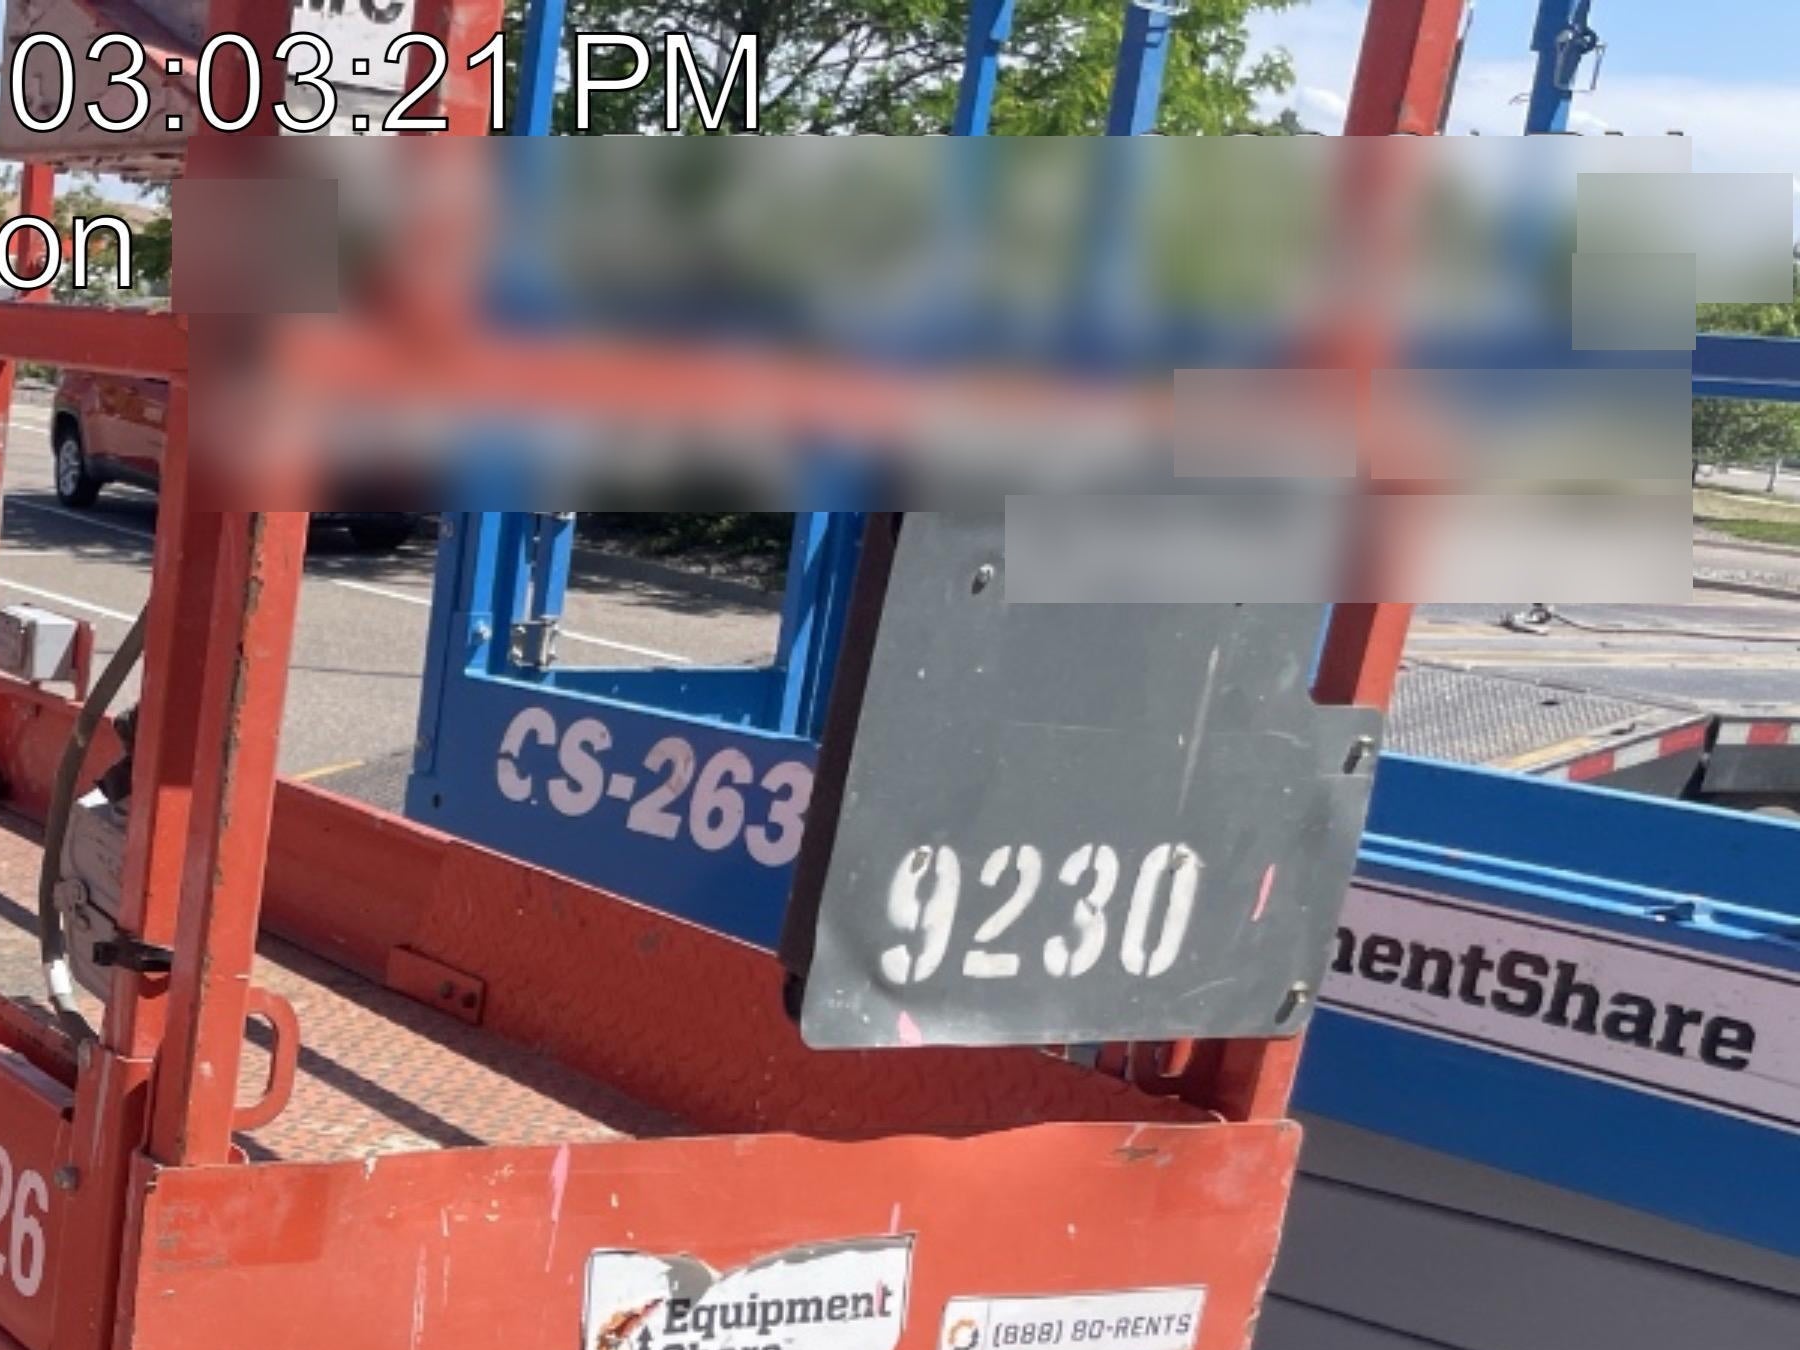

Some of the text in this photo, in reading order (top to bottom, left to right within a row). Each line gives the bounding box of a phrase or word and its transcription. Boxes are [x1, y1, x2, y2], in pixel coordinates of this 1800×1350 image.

[880, 842, 1202, 985] 9230
[663, 1284, 894, 1341] Equipment
[992, 1312, 1192, 1349] (888) 80-RENTS
